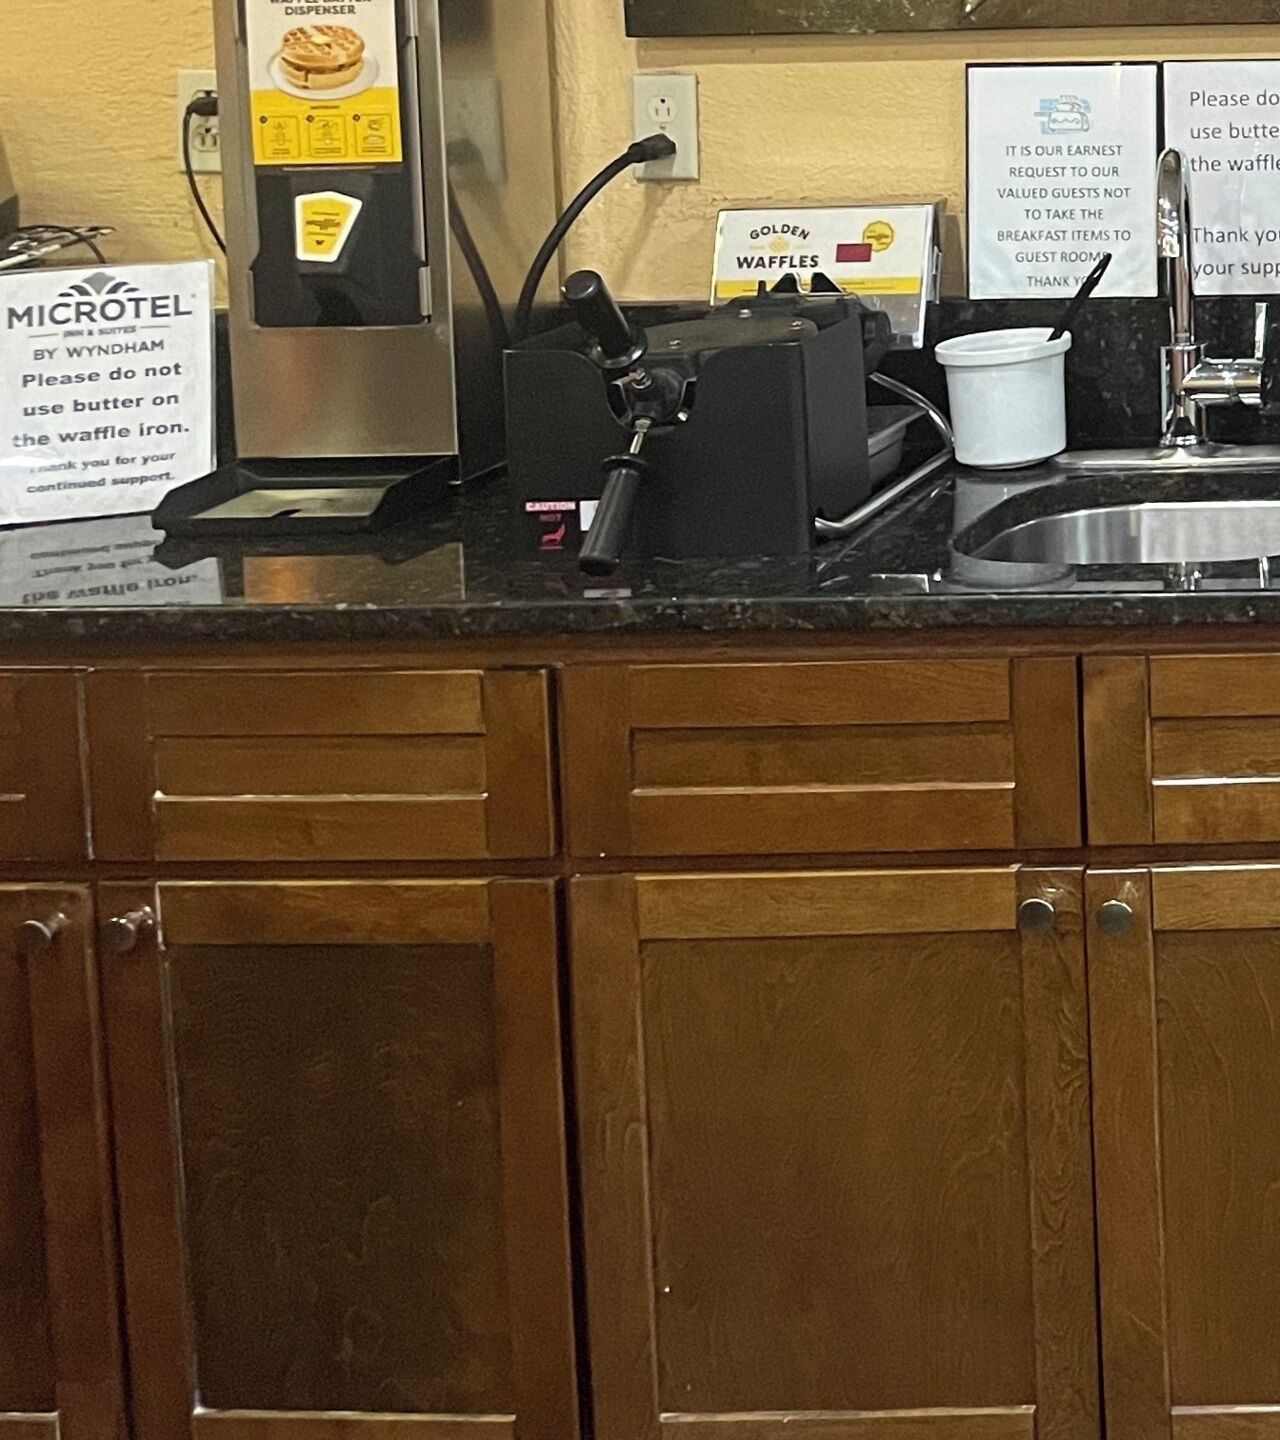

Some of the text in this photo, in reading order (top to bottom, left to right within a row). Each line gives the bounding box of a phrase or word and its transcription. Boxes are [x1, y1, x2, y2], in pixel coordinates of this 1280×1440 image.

[284, 5, 356, 16] DISPENSER
[1189, 90, 1250, 107] Please
[1256, 89, 1280, 106] do
[1189, 127, 1222, 139] use
[1005, 145, 1122, 156] IT IS OUR EARNEST
[1190, 156, 1221, 172] the
[1009, 166, 1119, 179] REQUEST TO OUR
[997, 187, 1131, 199] VALUED GUESTS NOT
[1024, 208, 1104, 220] TO TAKE THE
[749, 223, 811, 241] GOLDEN
[997, 229, 1131, 241] BREAKFAST ITEMS TO
[1193, 226, 1249, 243] Thank
[736, 254, 819, 270] WAFFLES
[1015, 251, 1057, 263] GUEST
[1193, 262, 1235, 279] your
[1026, 275, 1069, 287] THANK
[7, 294, 193, 330] MICROTEL
[98, 325, 137, 336] SUITES
[33, 339, 165, 361] BY WYNDHAM
[22, 362, 182, 388] Please do not
[23, 393, 179, 417] use butter on
[12, 422, 189, 448] the waffle iron.
[81, 458, 110, 471] you
[114, 454, 137, 465] for
[141, 451, 176, 466] your
[27, 470, 175, 494] continued support.
[526, 502, 576, 511] CAUTION
